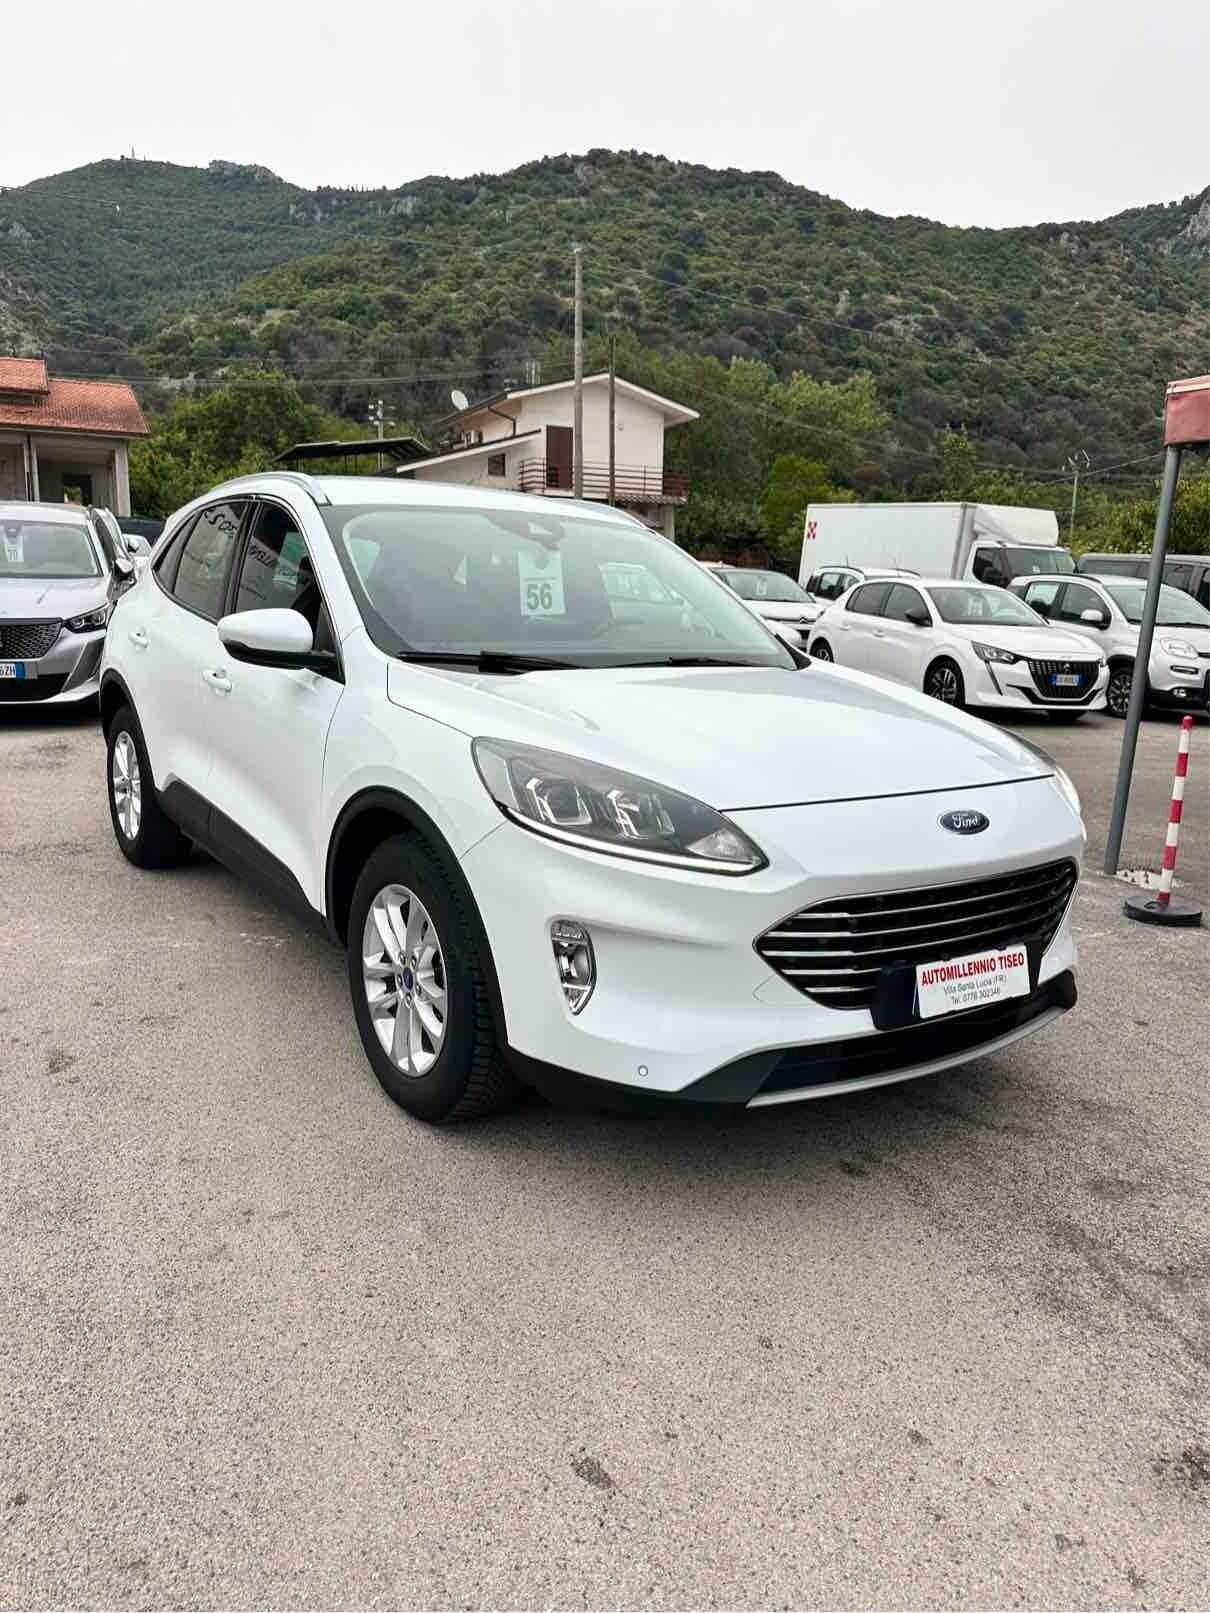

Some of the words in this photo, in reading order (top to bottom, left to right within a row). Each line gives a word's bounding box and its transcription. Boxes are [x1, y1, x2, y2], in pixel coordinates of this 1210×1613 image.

[528, 584, 552, 609] 56
[921, 957, 997, 985] AUTOMILLENNIO
[999, 952, 1025, 970] TISEO
[957, 980, 975, 991] Santa
[976, 978, 992, 988] Lucia
